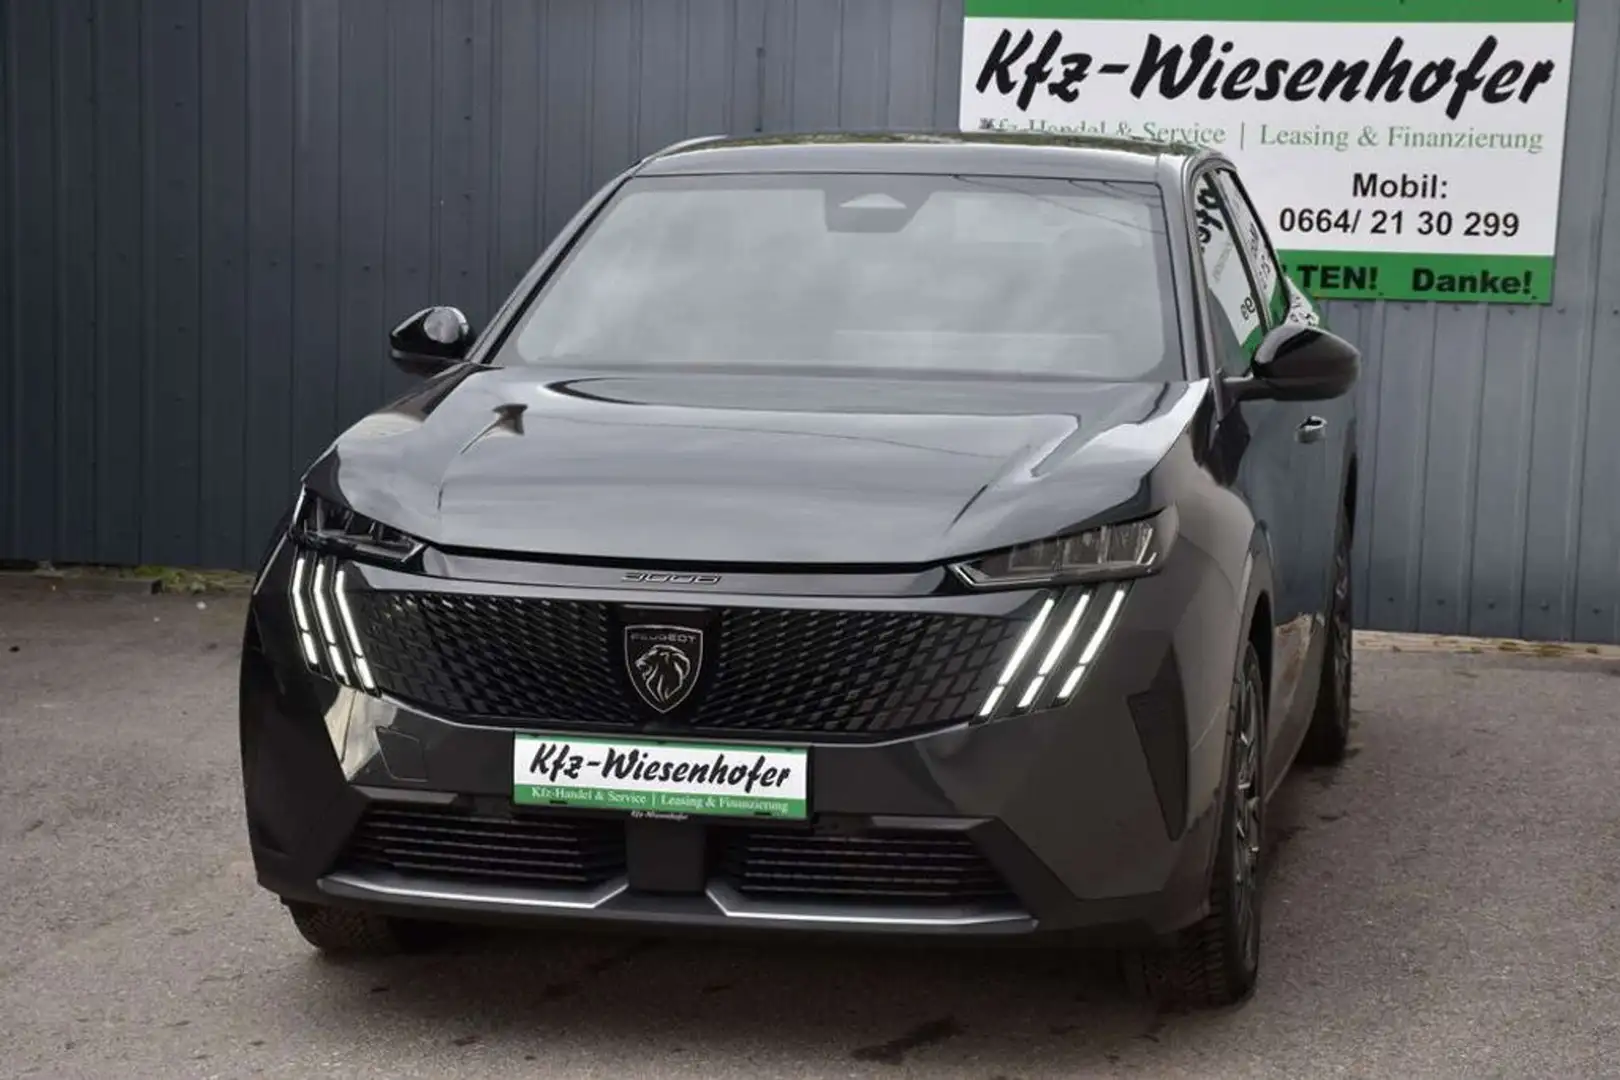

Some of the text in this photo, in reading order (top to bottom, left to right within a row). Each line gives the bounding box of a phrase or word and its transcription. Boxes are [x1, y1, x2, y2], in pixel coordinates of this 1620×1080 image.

[975, 28, 1556, 120] Kfz-Wiesenhofer
[1142, 121, 1227, 144] Service
[1260, 124, 1349, 151] Leasing
[1357, 126, 1379, 147] &
[1388, 126, 1544, 154] Finanzierung
[1352, 172, 1449, 199] Mobil:
[1279, 207, 1520, 237] 0664/ 21 30 299
[1412, 267, 1534, 293] Danke!
[529, 743, 791, 794] Kfz-Wiesenhofer
[531, 786, 593, 801] Kfz-Handel
[607, 790, 647, 805] Service
[661, 794, 702, 810] Leasing
[719, 797, 789, 814] Finanzierung
